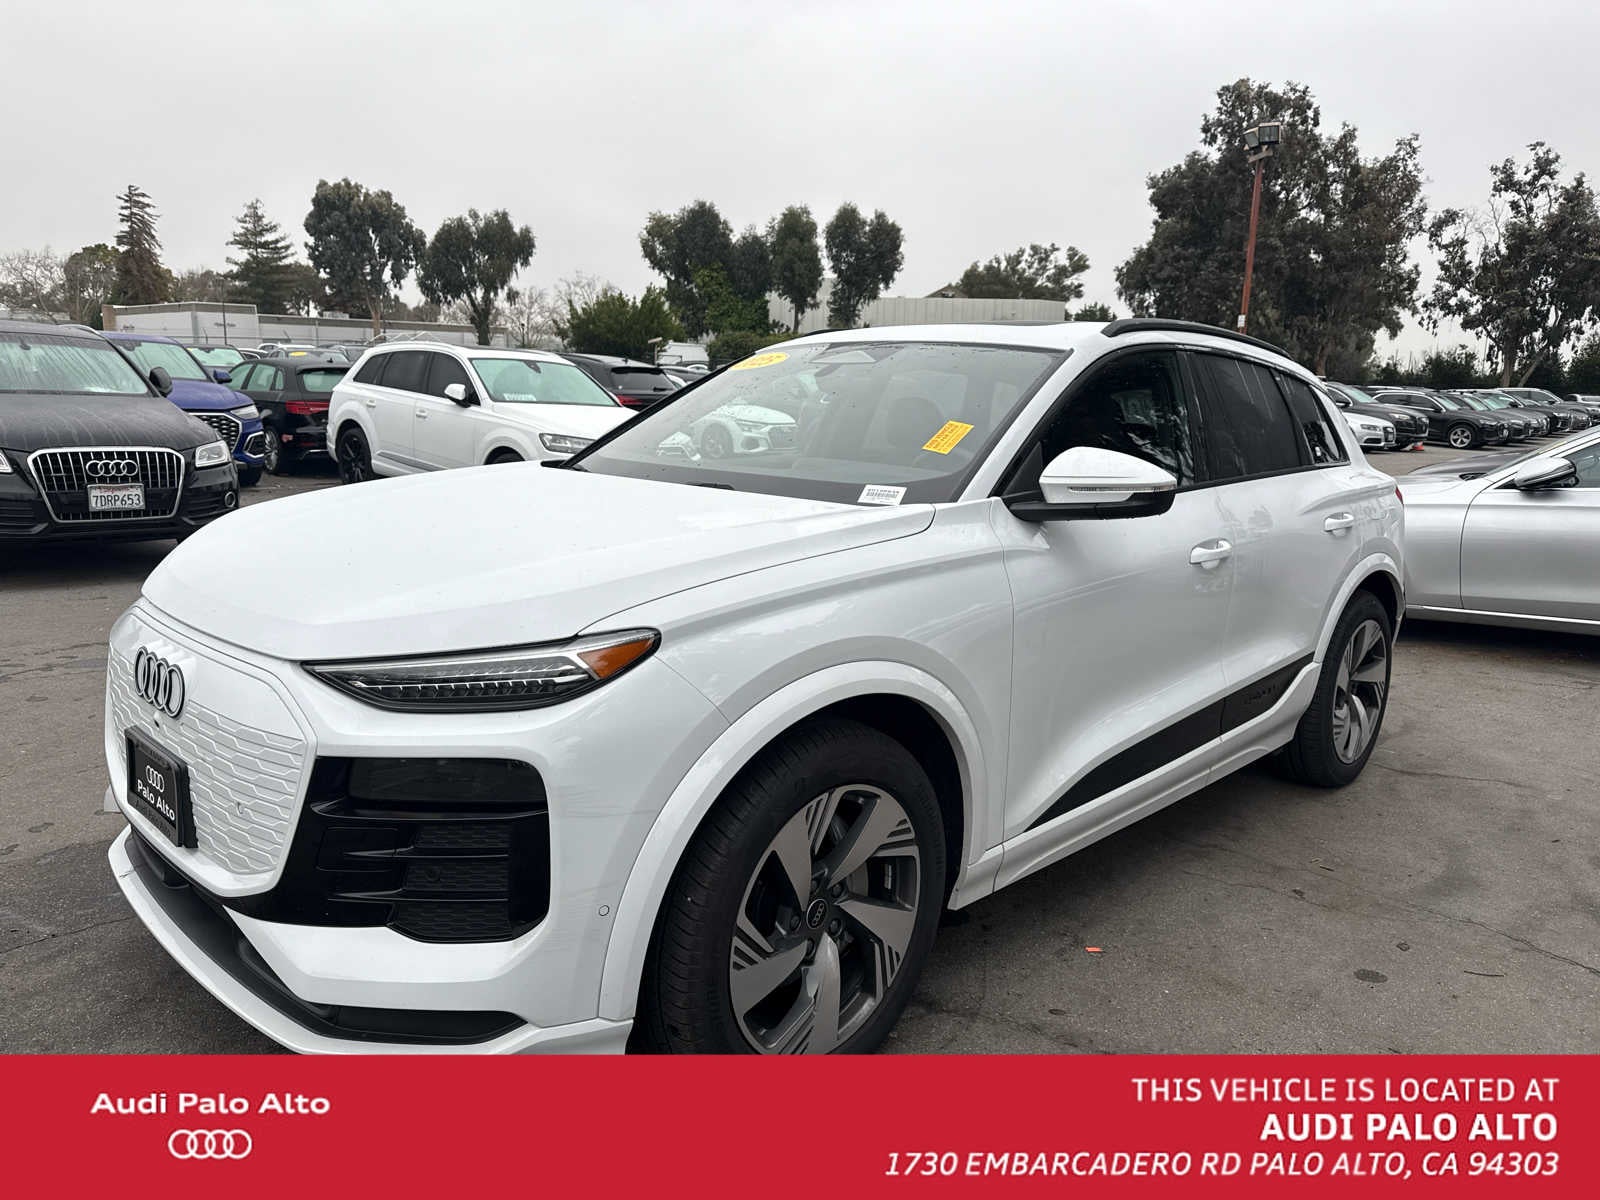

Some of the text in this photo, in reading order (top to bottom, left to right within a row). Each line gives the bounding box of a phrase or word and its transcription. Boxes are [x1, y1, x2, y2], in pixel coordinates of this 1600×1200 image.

[92, 493, 141, 507] 7DRP653
[137, 779, 175, 821] Palo Alto
